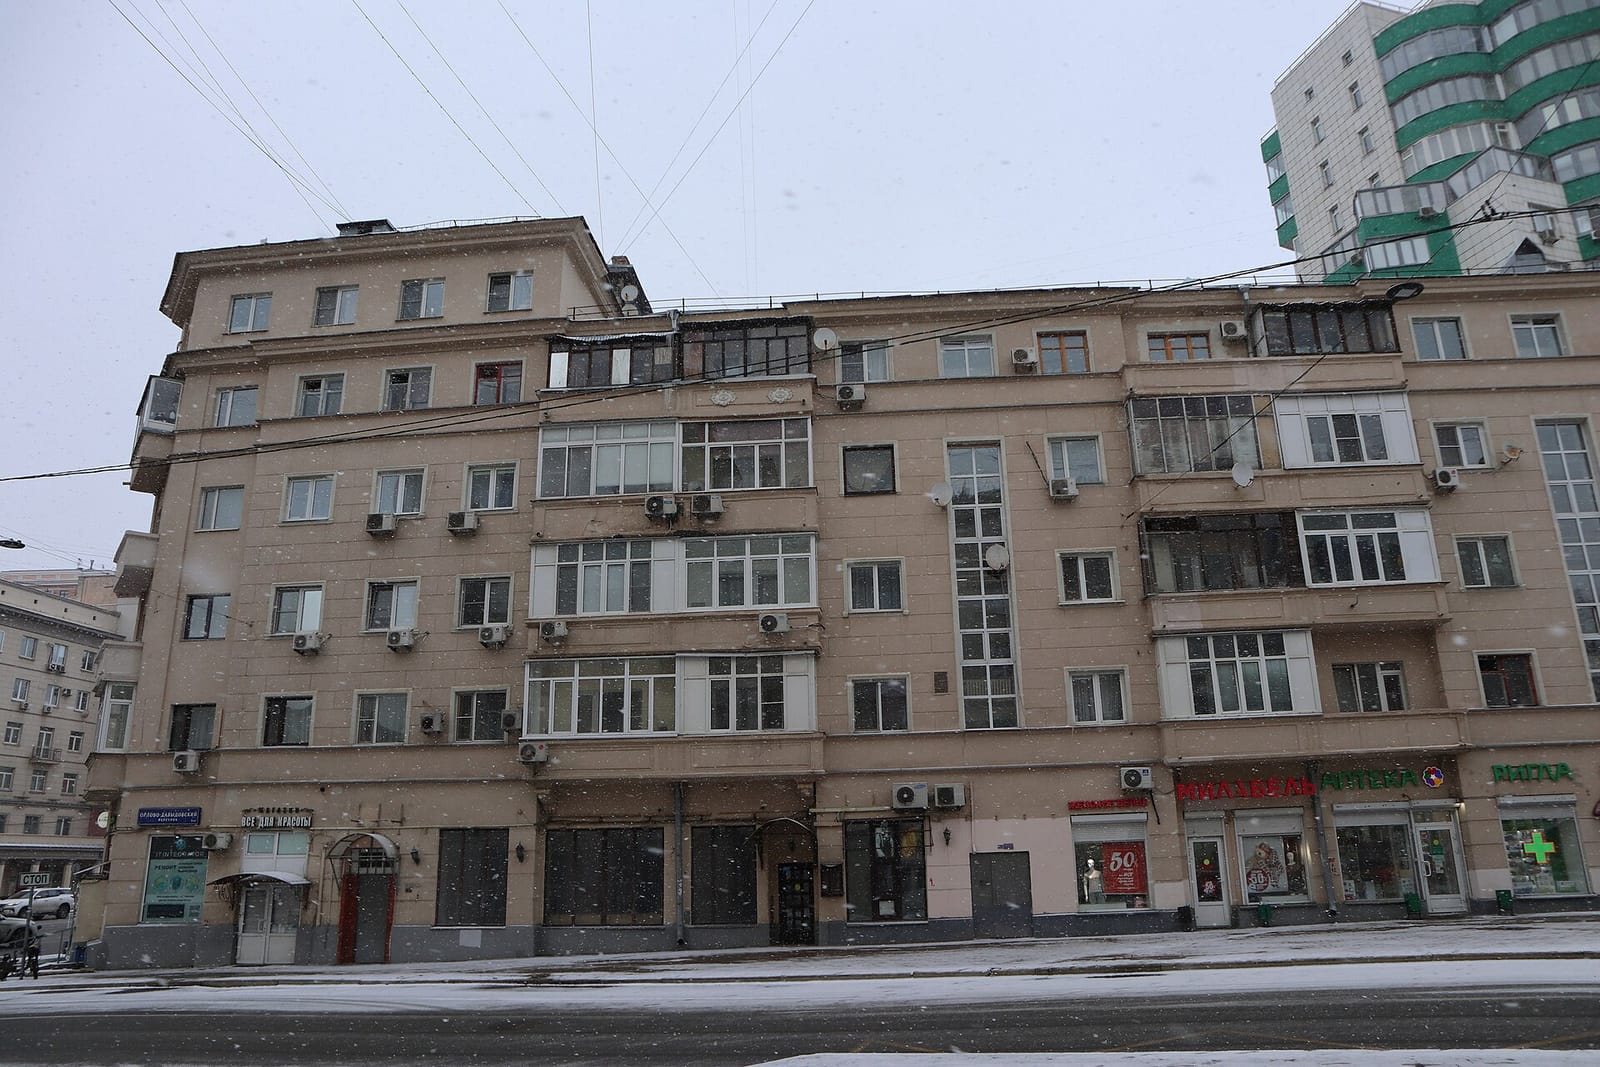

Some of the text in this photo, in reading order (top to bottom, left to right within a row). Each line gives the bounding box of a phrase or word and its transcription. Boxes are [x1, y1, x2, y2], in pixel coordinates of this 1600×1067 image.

[1320, 768, 1418, 790] АПТЕКА
[1492, 762, 1574, 783] РИГЛА
[241, 815, 312, 828] ВСЕ ДЛЯ КРАСОТЫ
[1109, 851, 1135, 872] 50
[23, 874, 48, 884] СТОП
